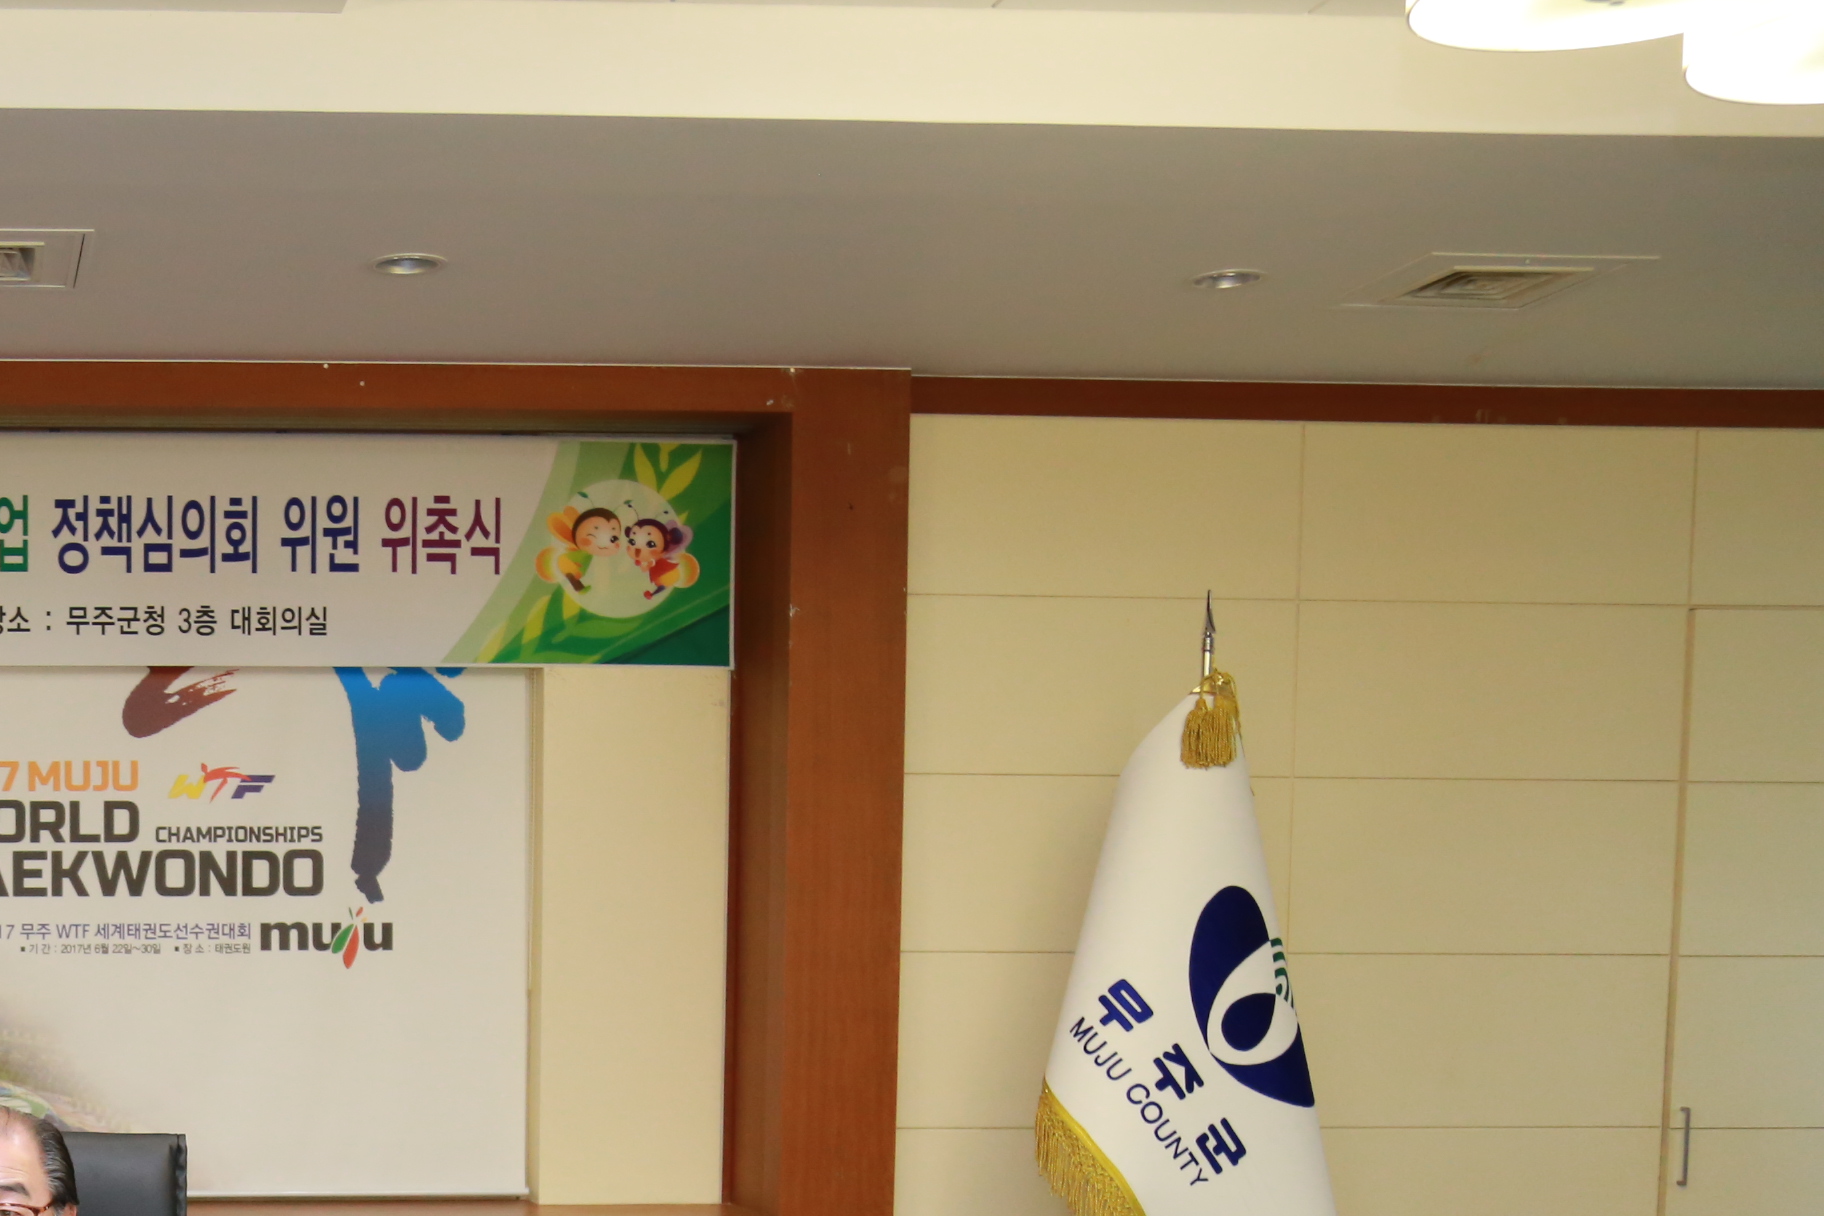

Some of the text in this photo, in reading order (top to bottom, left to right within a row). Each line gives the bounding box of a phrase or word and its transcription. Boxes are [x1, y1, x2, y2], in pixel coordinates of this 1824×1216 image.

[52, 495, 257, 574] 정책심의회
[281, 495, 359, 574] 위원
[381, 495, 501, 575] 위촉식
[67, 606, 164, 636] 무주군청
[178, 605, 217, 636] 3층
[231, 606, 327, 635] 대회의실
[28, 760, 138, 791] MUJU
[156, 826, 323, 843] CHAMPIONSHIPS
[20, 924, 51, 940] 무주
[56, 924, 90, 938] WTF
[95, 923, 250, 939] 세계태권도선수권대회
[61, 944, 91, 954] 2017년
[95, 943, 109, 954] 6월
[215, 943, 250, 954] 태권도원
[1070, 1017, 1208, 1187] MUJU COUNTY
